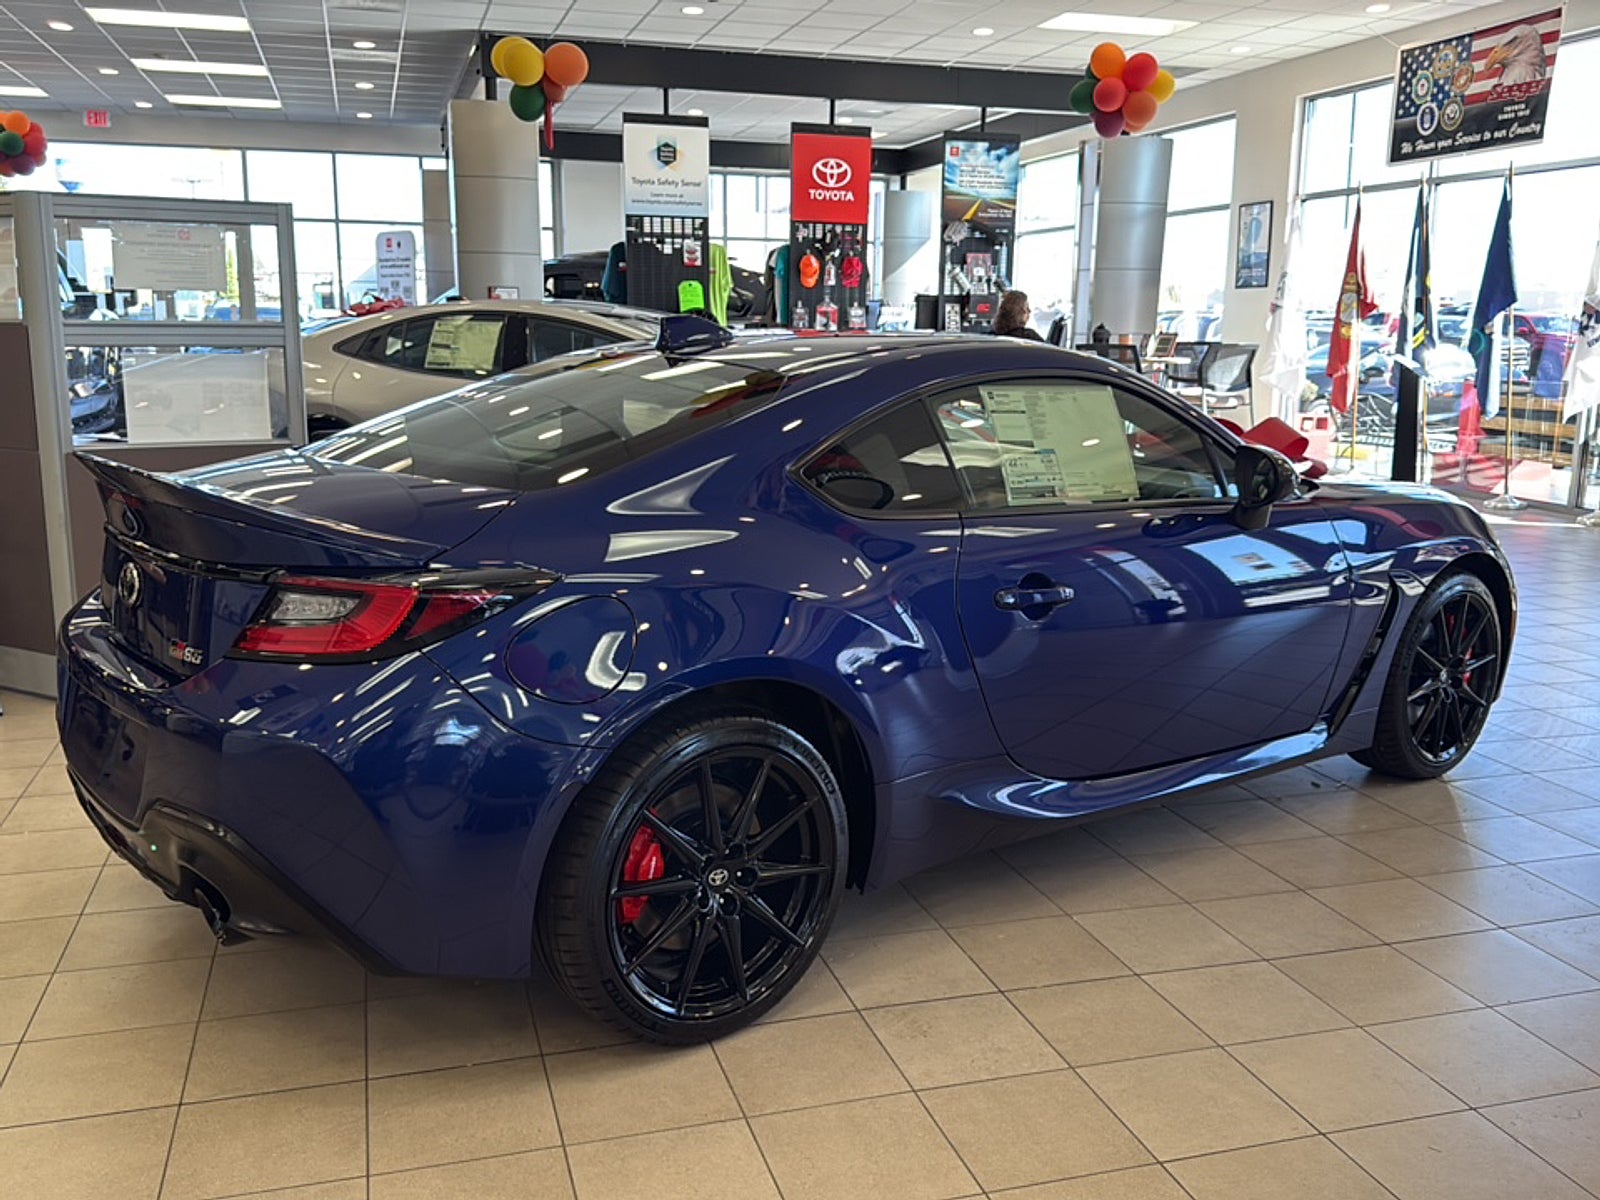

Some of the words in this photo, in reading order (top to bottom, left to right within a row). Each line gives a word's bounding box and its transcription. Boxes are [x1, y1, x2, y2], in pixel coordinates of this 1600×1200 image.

[86, 110, 109, 127] EXIT
[1401, 141, 1413, 154] We
[1415, 139, 1436, 151] Honor
[1436, 138, 1453, 150] your
[1455, 132, 1481, 145] Service
[1483, 130, 1492, 140] to
[1493, 129, 1507, 138] our
[1508, 122, 1541, 138] Country
[631, 177, 655, 187] Toyota
[657, 178, 679, 188] Safety
[681, 179, 701, 187] Sense
[808, 188, 855, 202] TOYOTA
